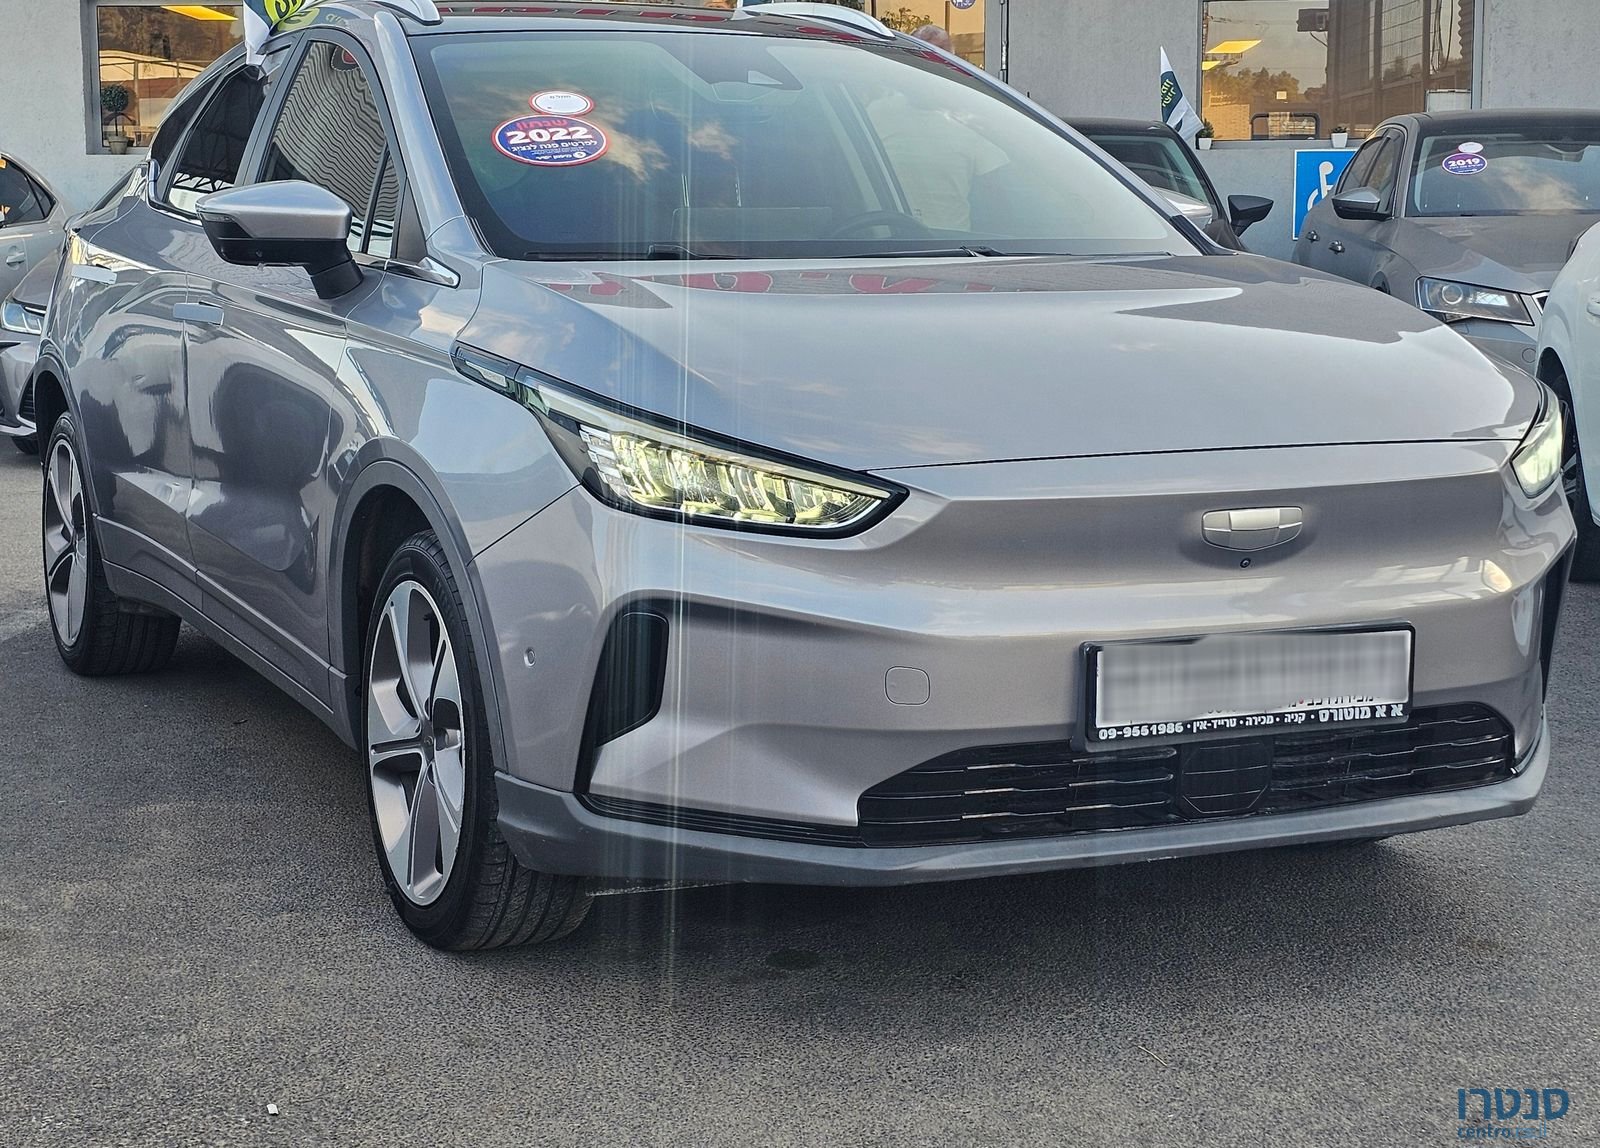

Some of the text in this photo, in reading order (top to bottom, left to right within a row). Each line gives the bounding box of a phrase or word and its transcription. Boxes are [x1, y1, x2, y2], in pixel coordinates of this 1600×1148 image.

[506, 127, 593, 144] 2022
[1318, 706, 1372, 722] מוטורס
[1375, 704, 1387, 718] א
[1391, 703, 1404, 717] א
[1245, 715, 1274, 726] מכירה
[1284, 712, 1306, 724] קניה
[1098, 722, 1184, 740] 09-9551986
